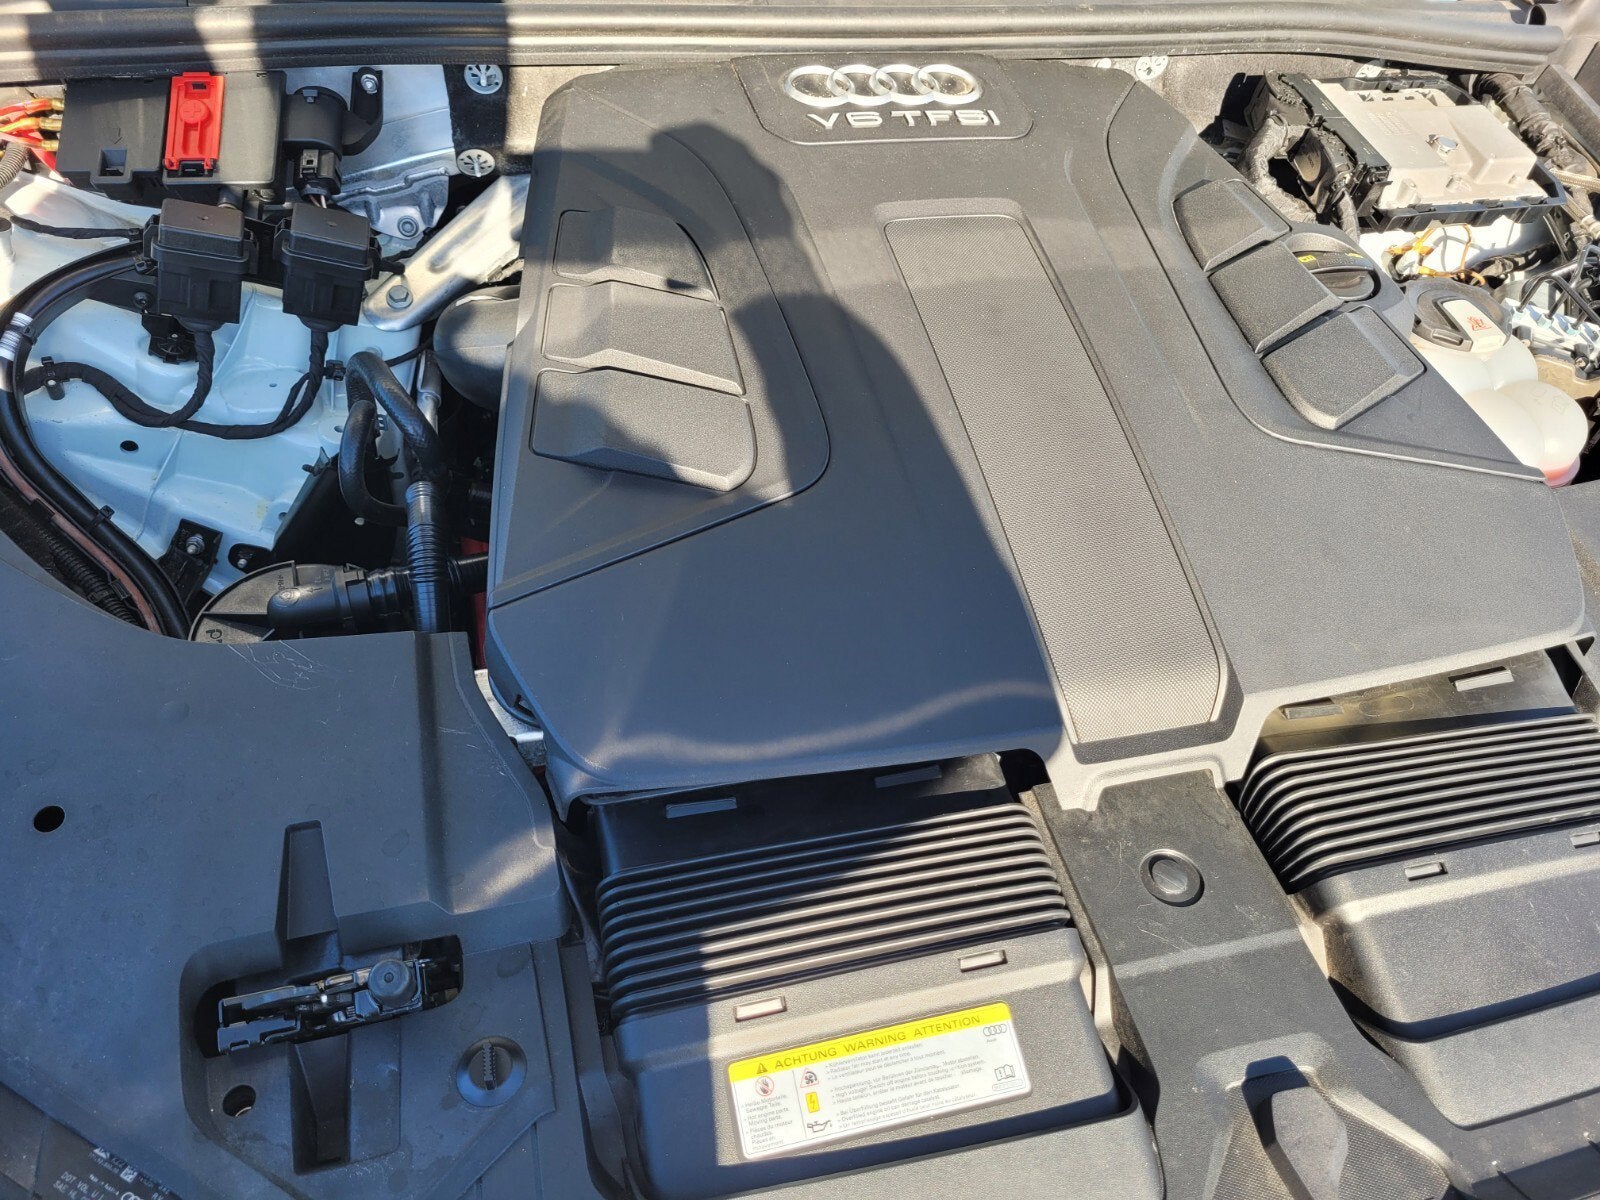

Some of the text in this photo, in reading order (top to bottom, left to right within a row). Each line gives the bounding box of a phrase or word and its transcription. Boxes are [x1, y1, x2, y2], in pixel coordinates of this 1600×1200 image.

[806, 110, 1000, 130] V6 TFSI
[775, 1015, 981, 1068] ACHTUNG WARNING ATTENTION
